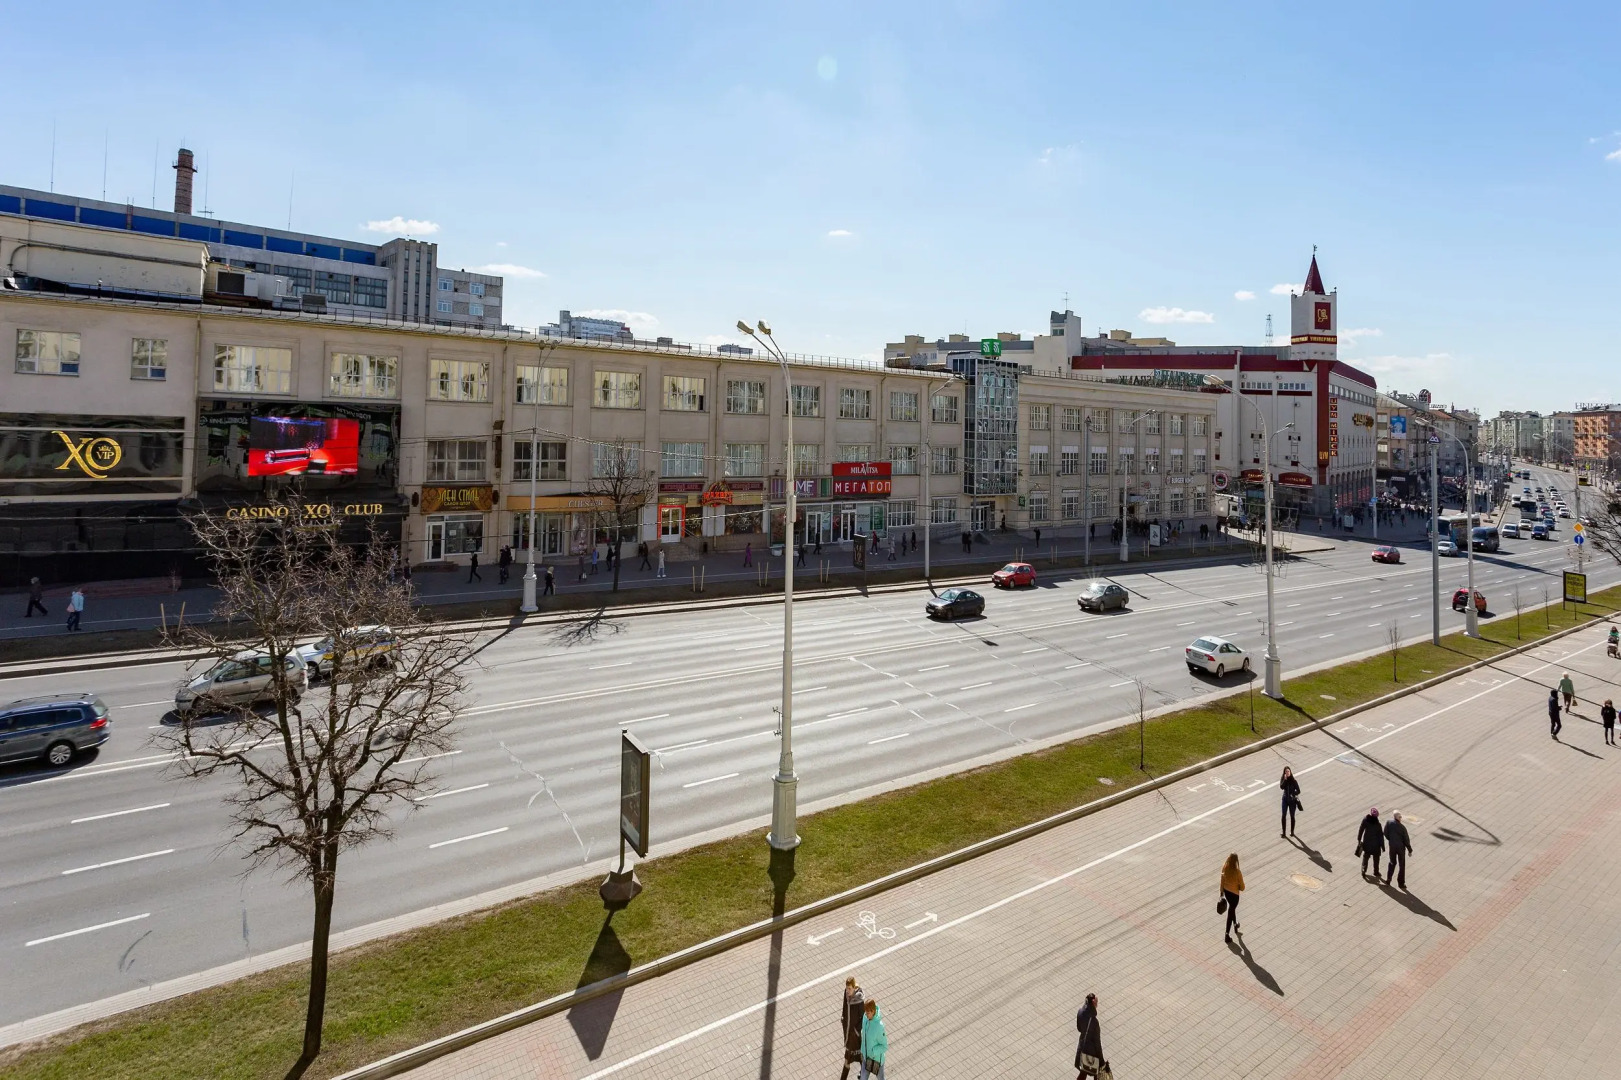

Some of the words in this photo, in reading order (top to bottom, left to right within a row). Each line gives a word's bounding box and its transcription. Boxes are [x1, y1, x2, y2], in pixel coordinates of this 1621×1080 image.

[51, 430, 122, 478] XO
[96, 451, 115, 460] VIP
[796, 481, 814, 493] MF
[835, 481, 891, 493] МЕГАТОП
[458, 488, 480, 502] СТИЛЬ
[226, 506, 289, 520] CASINO
[304, 503, 331, 519] XO
[344, 503, 383, 516] CLUB
